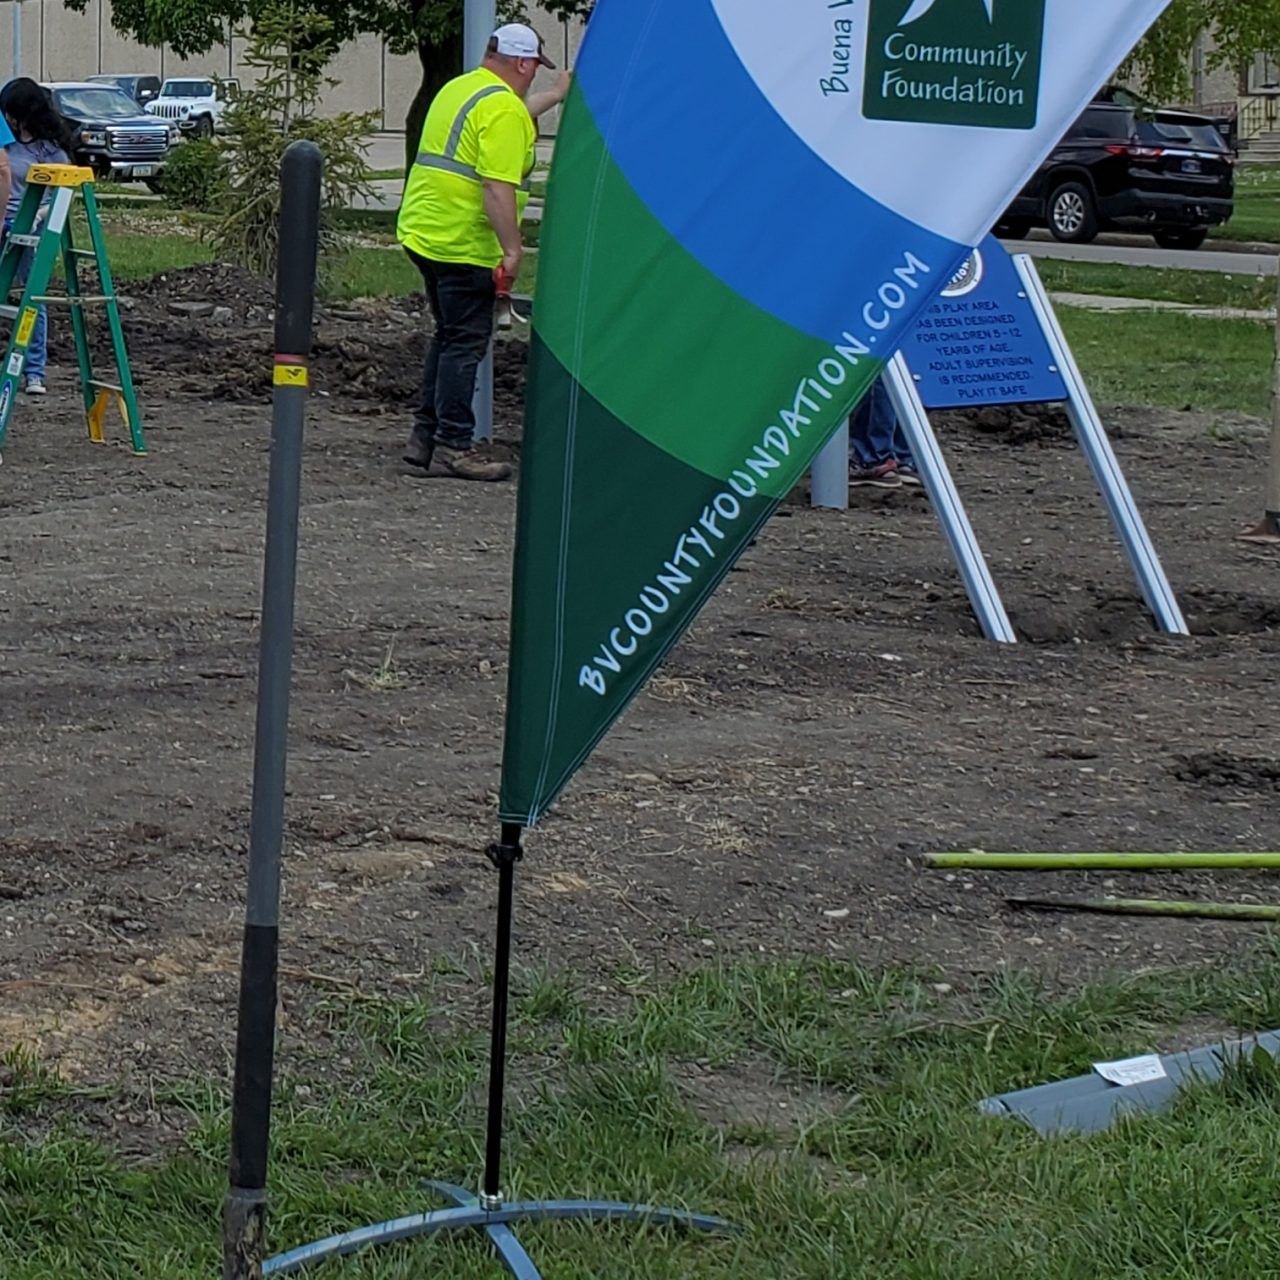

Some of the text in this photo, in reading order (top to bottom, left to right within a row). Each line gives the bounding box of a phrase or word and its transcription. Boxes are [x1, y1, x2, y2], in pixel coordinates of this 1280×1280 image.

[819, 18, 853, 98] Buena
[883, 32, 1028, 81] Community
[881, 68, 1024, 106] Foundation
[943, 302, 970, 313] PLAY
[972, 301, 1000, 311] AREA
[934, 318, 964, 328] BEEN
[964, 314, 1017, 326] DESIGNED
[916, 333, 938, 343] FOR
[939, 329, 992, 342] CHILDREN
[1009, 327, 1023, 338] 12
[936, 344, 971, 357] YEARS
[971, 344, 986, 354] OF
[928, 356, 1034, 371] ADULT SUPERVISION
[938, 375, 950, 385] IS
[957, 385, 1028, 398] PLAY IT SAFE
[578, 250, 931, 697] BVCOUNTYFOUNDATION.COM
